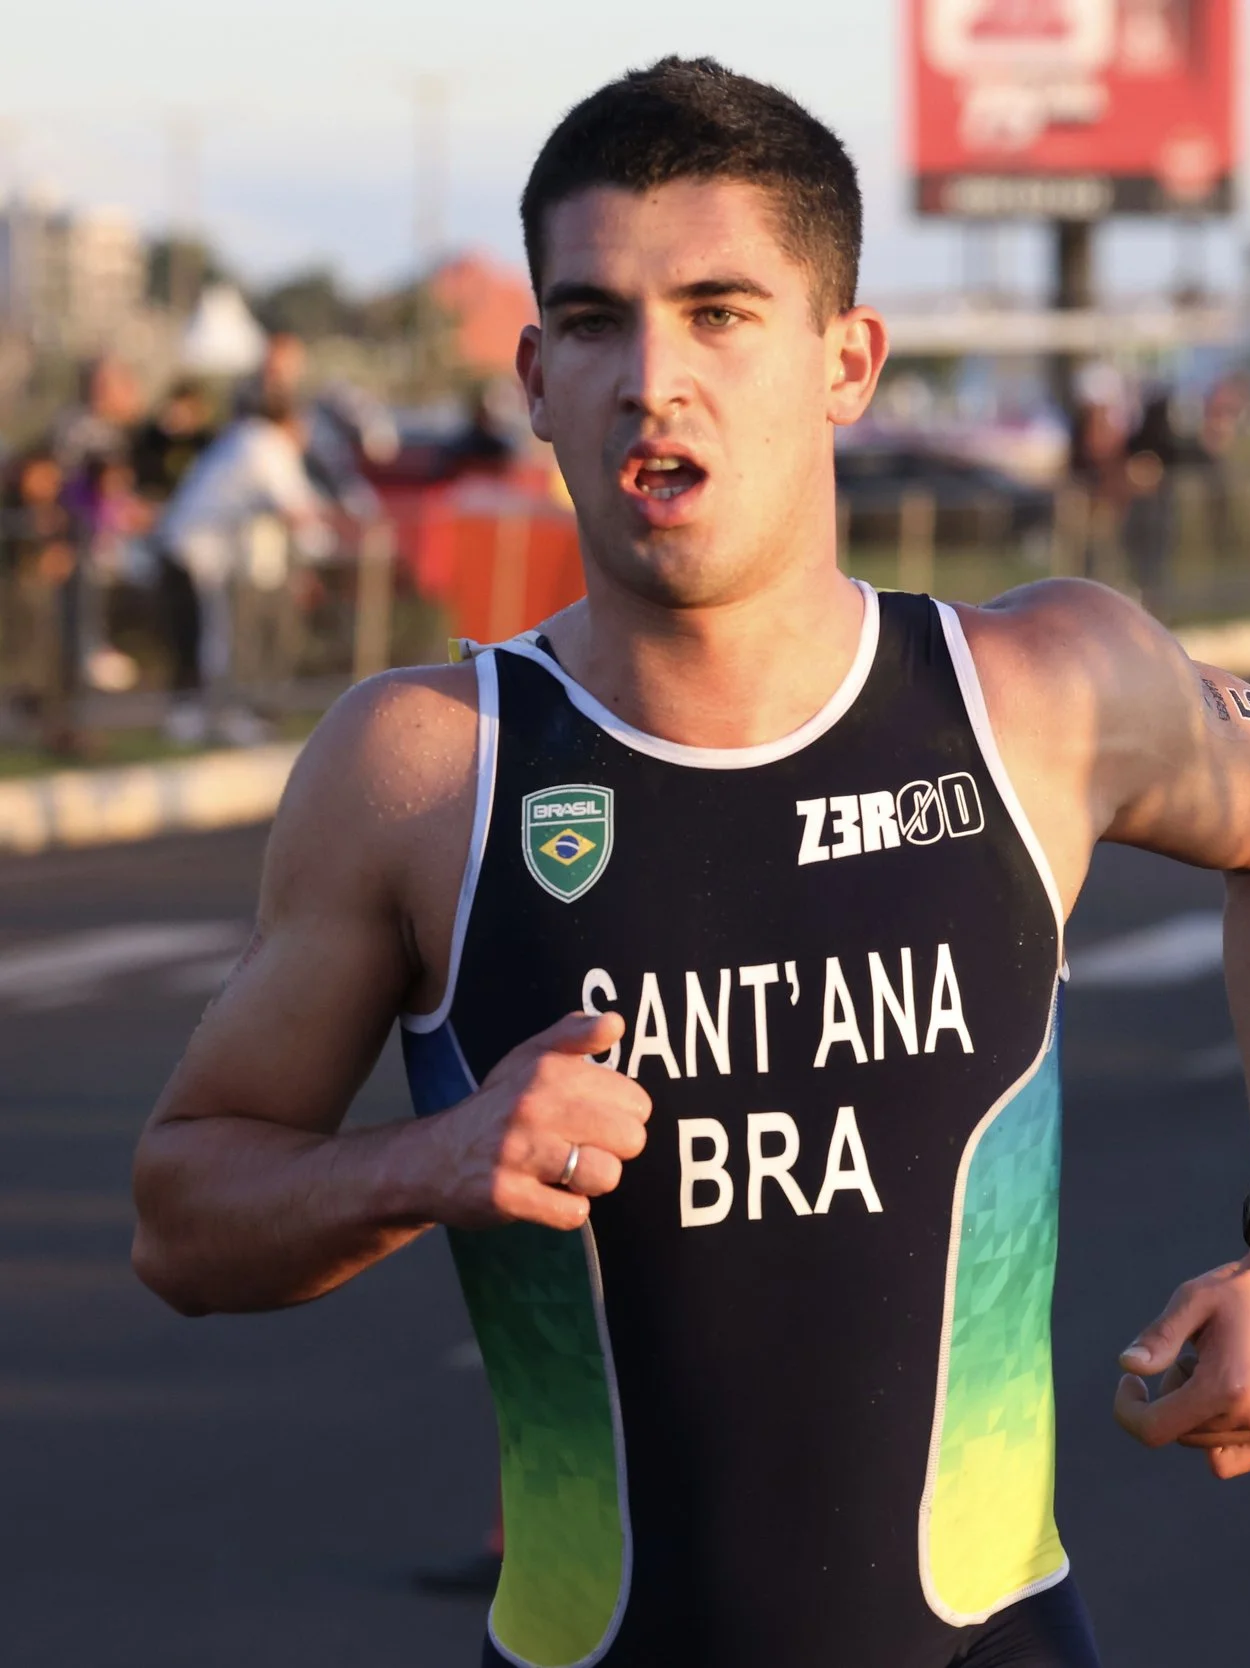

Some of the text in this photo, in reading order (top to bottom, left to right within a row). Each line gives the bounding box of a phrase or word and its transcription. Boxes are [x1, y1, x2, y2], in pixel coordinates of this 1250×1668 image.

[533, 801, 602, 819] BRASIL
[582, 943, 975, 1080] SANT'ANA
[677, 1106, 883, 1228] BRA
